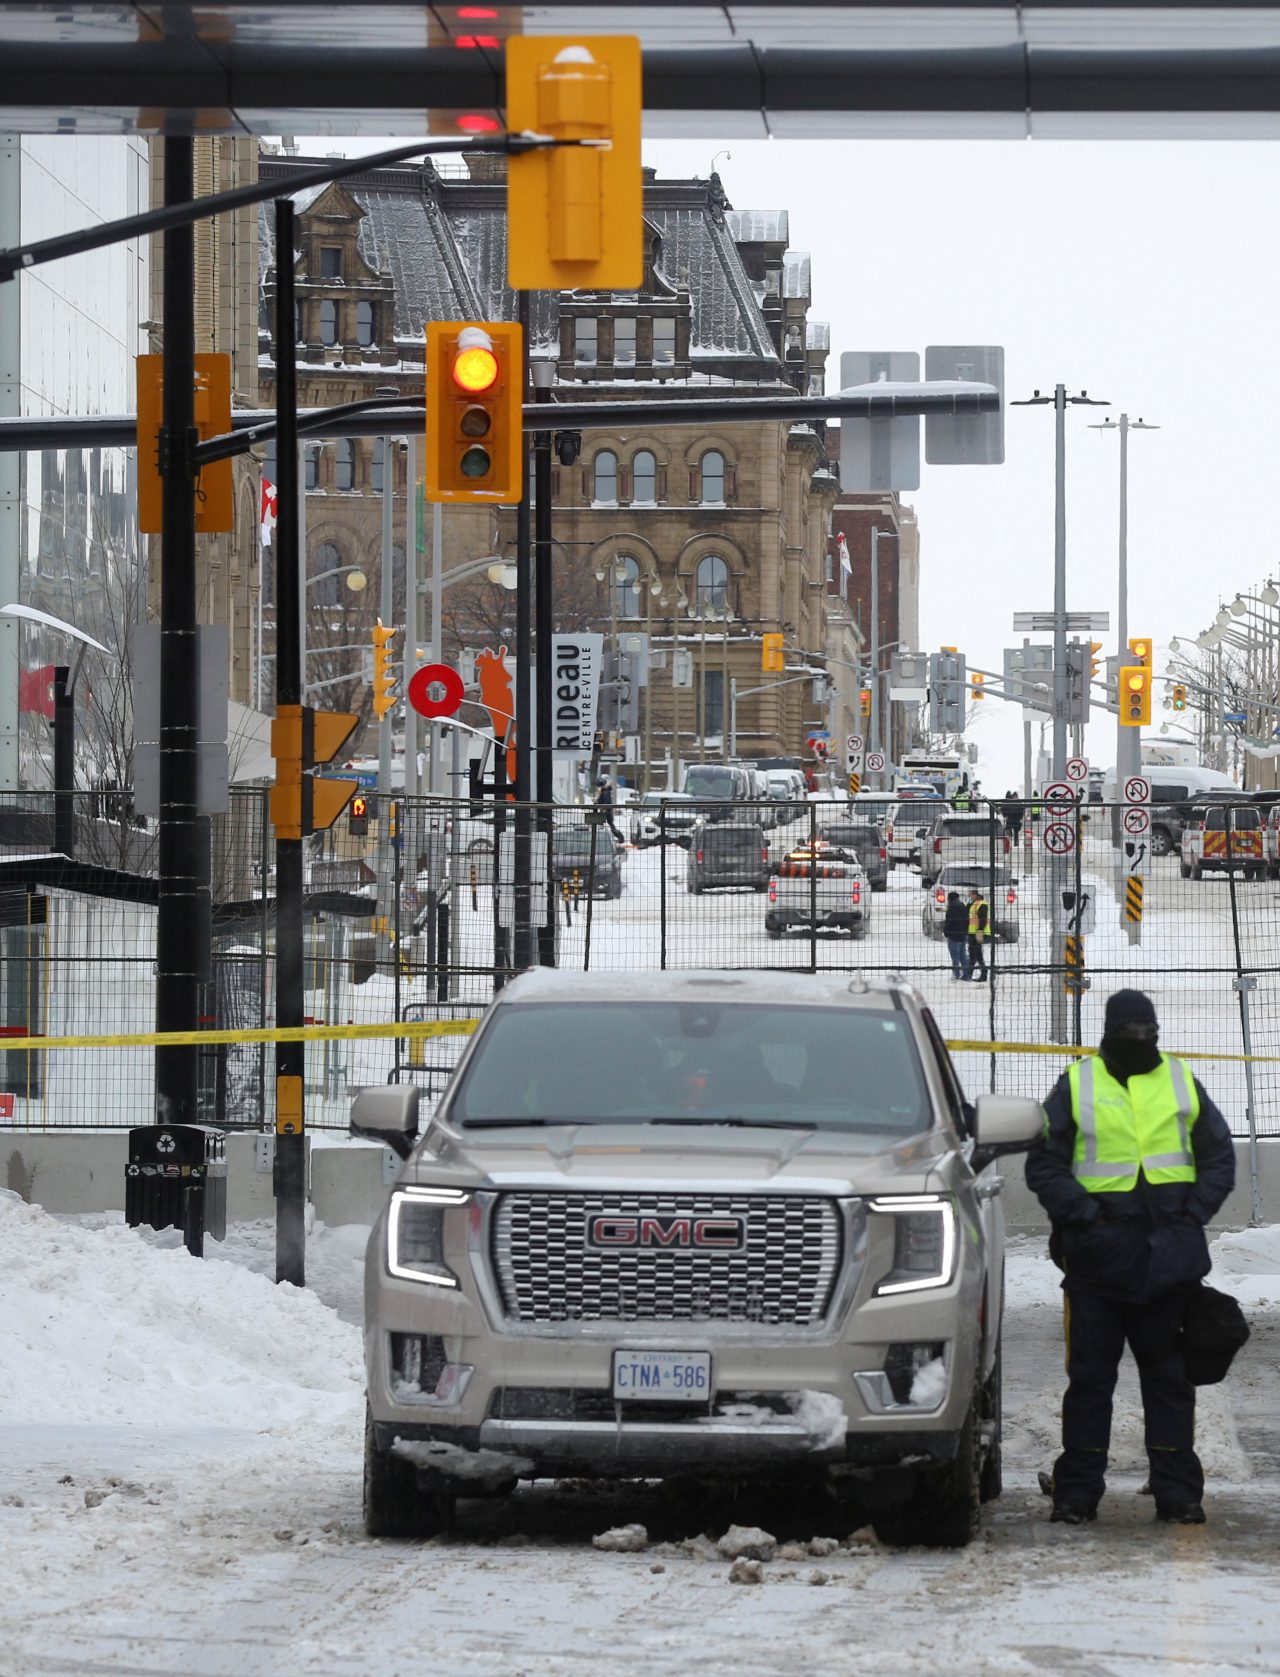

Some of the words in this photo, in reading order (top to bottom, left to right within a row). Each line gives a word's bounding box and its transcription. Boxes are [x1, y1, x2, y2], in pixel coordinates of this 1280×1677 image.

[582, 647, 591, 748] CENTRE-VILLE
[593, 1218, 739, 1246] GMC
[617, 1364, 660, 1387] CTNA
[673, 1365, 706, 1388] 586
